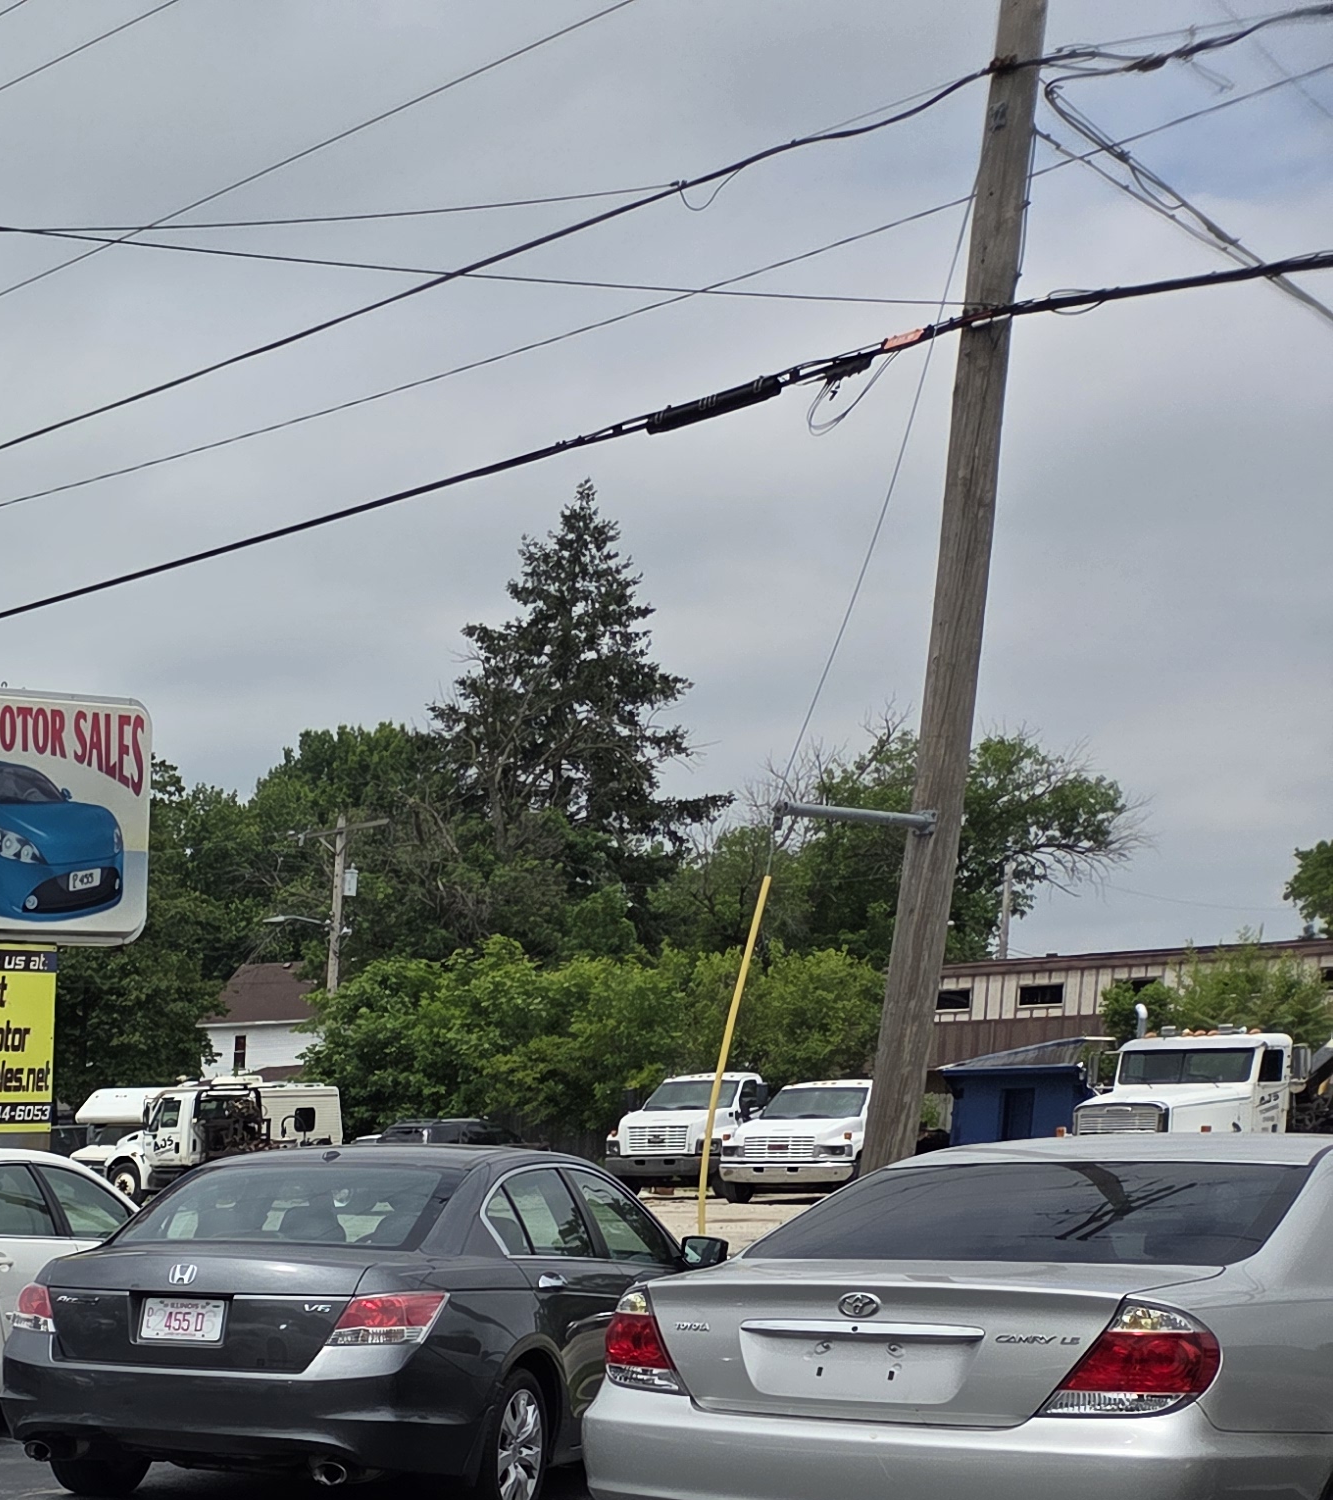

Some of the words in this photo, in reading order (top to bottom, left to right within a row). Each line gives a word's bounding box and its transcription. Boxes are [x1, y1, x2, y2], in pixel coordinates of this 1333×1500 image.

[73, 710, 145, 797] SALES
[4, 956, 26, 970] us
[29, 953, 49, 971] at:
[303, 1303, 331, 1313] V6
[164, 1311, 192, 1332] 455
[674, 1321, 710, 1332] TOYOTA
[995, 1334, 1058, 1345] CAMRY
[1060, 1336, 1081, 1346] LE
